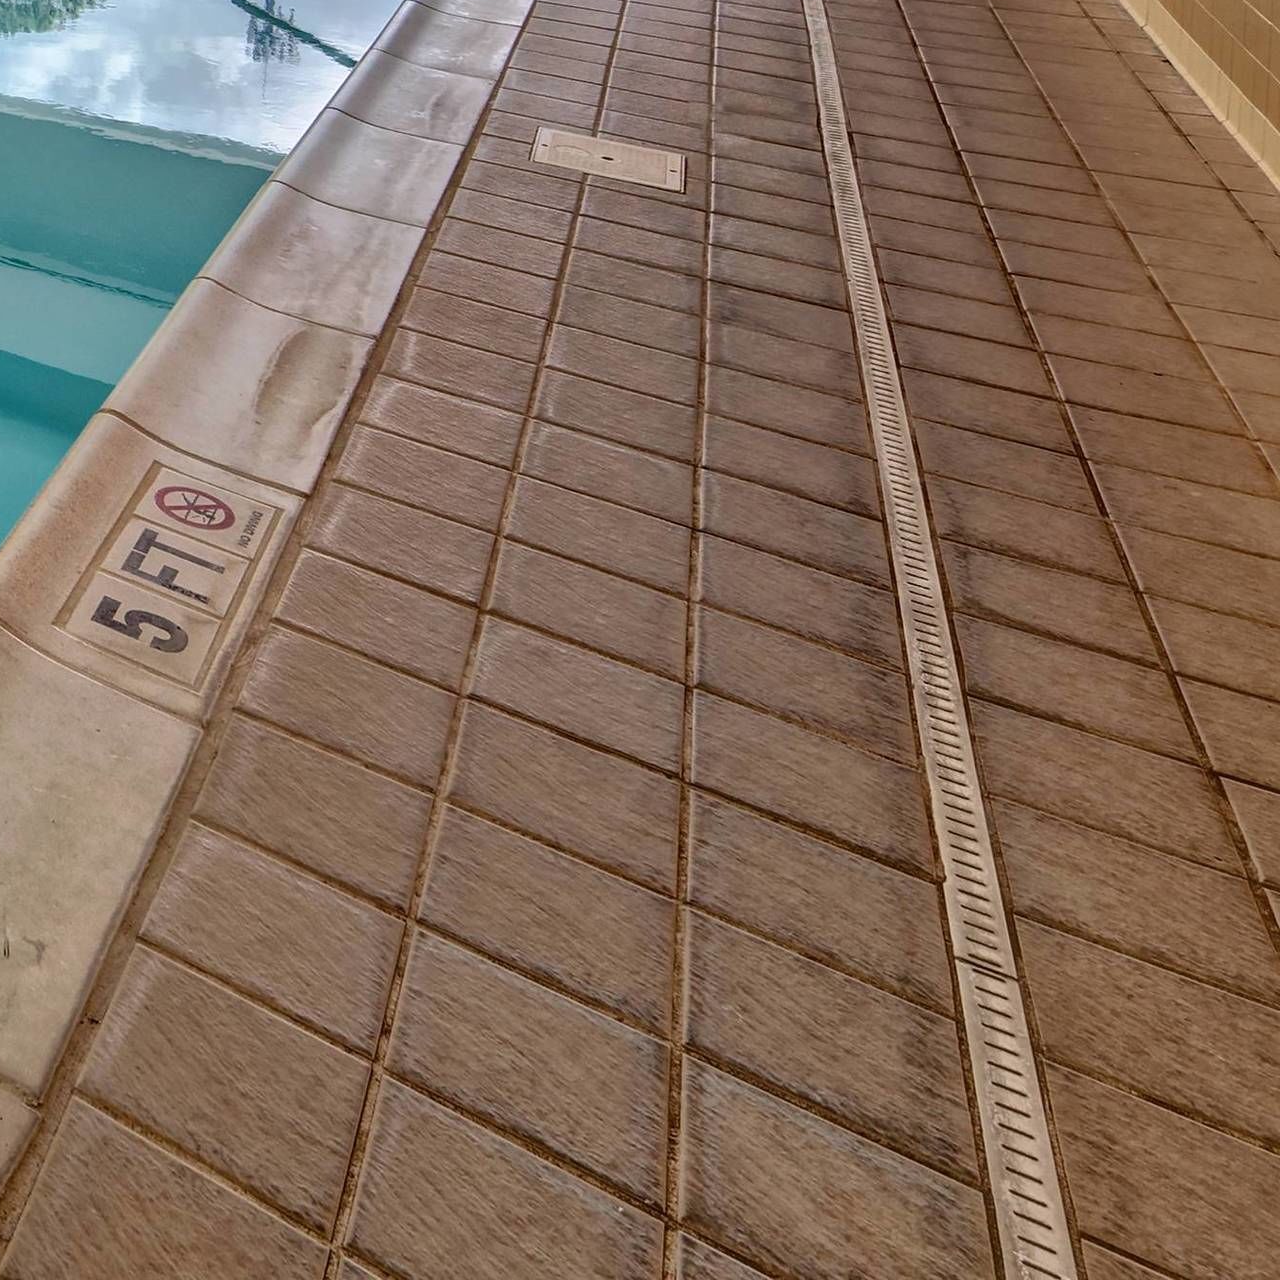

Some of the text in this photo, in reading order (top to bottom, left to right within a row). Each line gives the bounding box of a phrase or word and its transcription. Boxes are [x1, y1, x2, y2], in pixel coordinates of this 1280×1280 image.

[237, 511, 263, 549] NO DIVING
[91, 528, 226, 653] 5 FT
